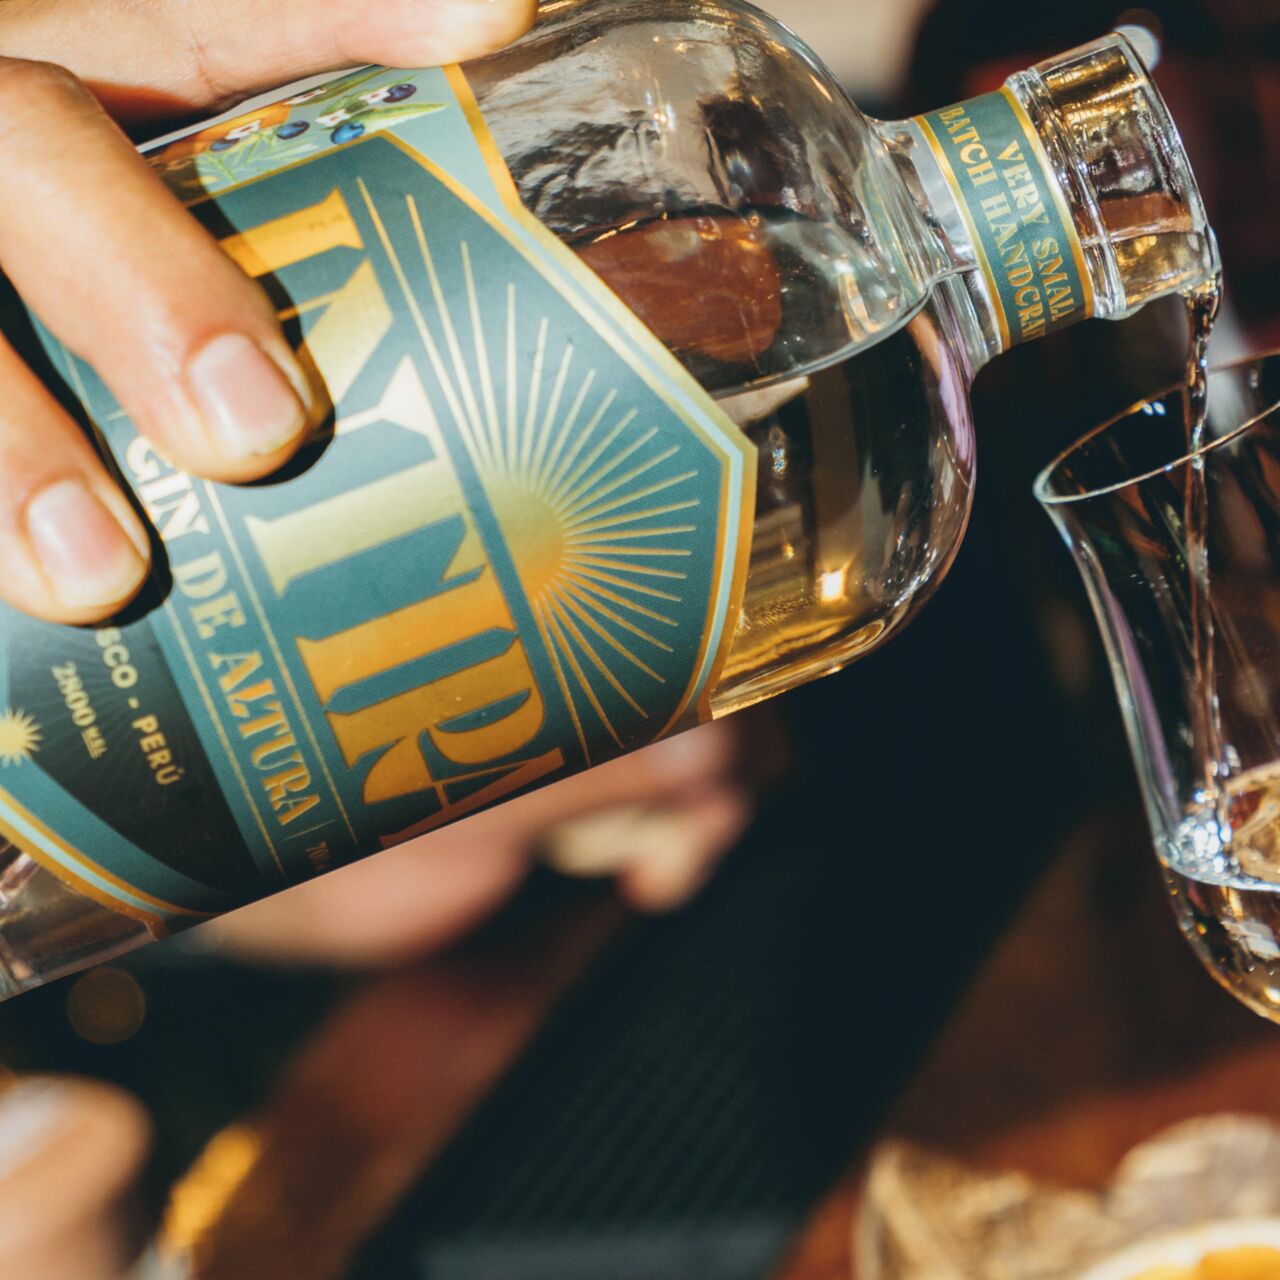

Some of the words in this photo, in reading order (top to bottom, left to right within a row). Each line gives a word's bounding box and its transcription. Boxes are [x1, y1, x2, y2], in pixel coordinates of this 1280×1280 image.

[938, 106, 998, 188] BATCH
[997, 140, 1049, 227] VERY
[1032, 237, 1074, 322] SMALL
[126, 435, 210, 541] GIN
[174, 551, 247, 640] DE
[51, 660, 97, 727] 2800
[131, 714, 185, 785] PERÚ
[207, 651, 321, 826] ALTURA
